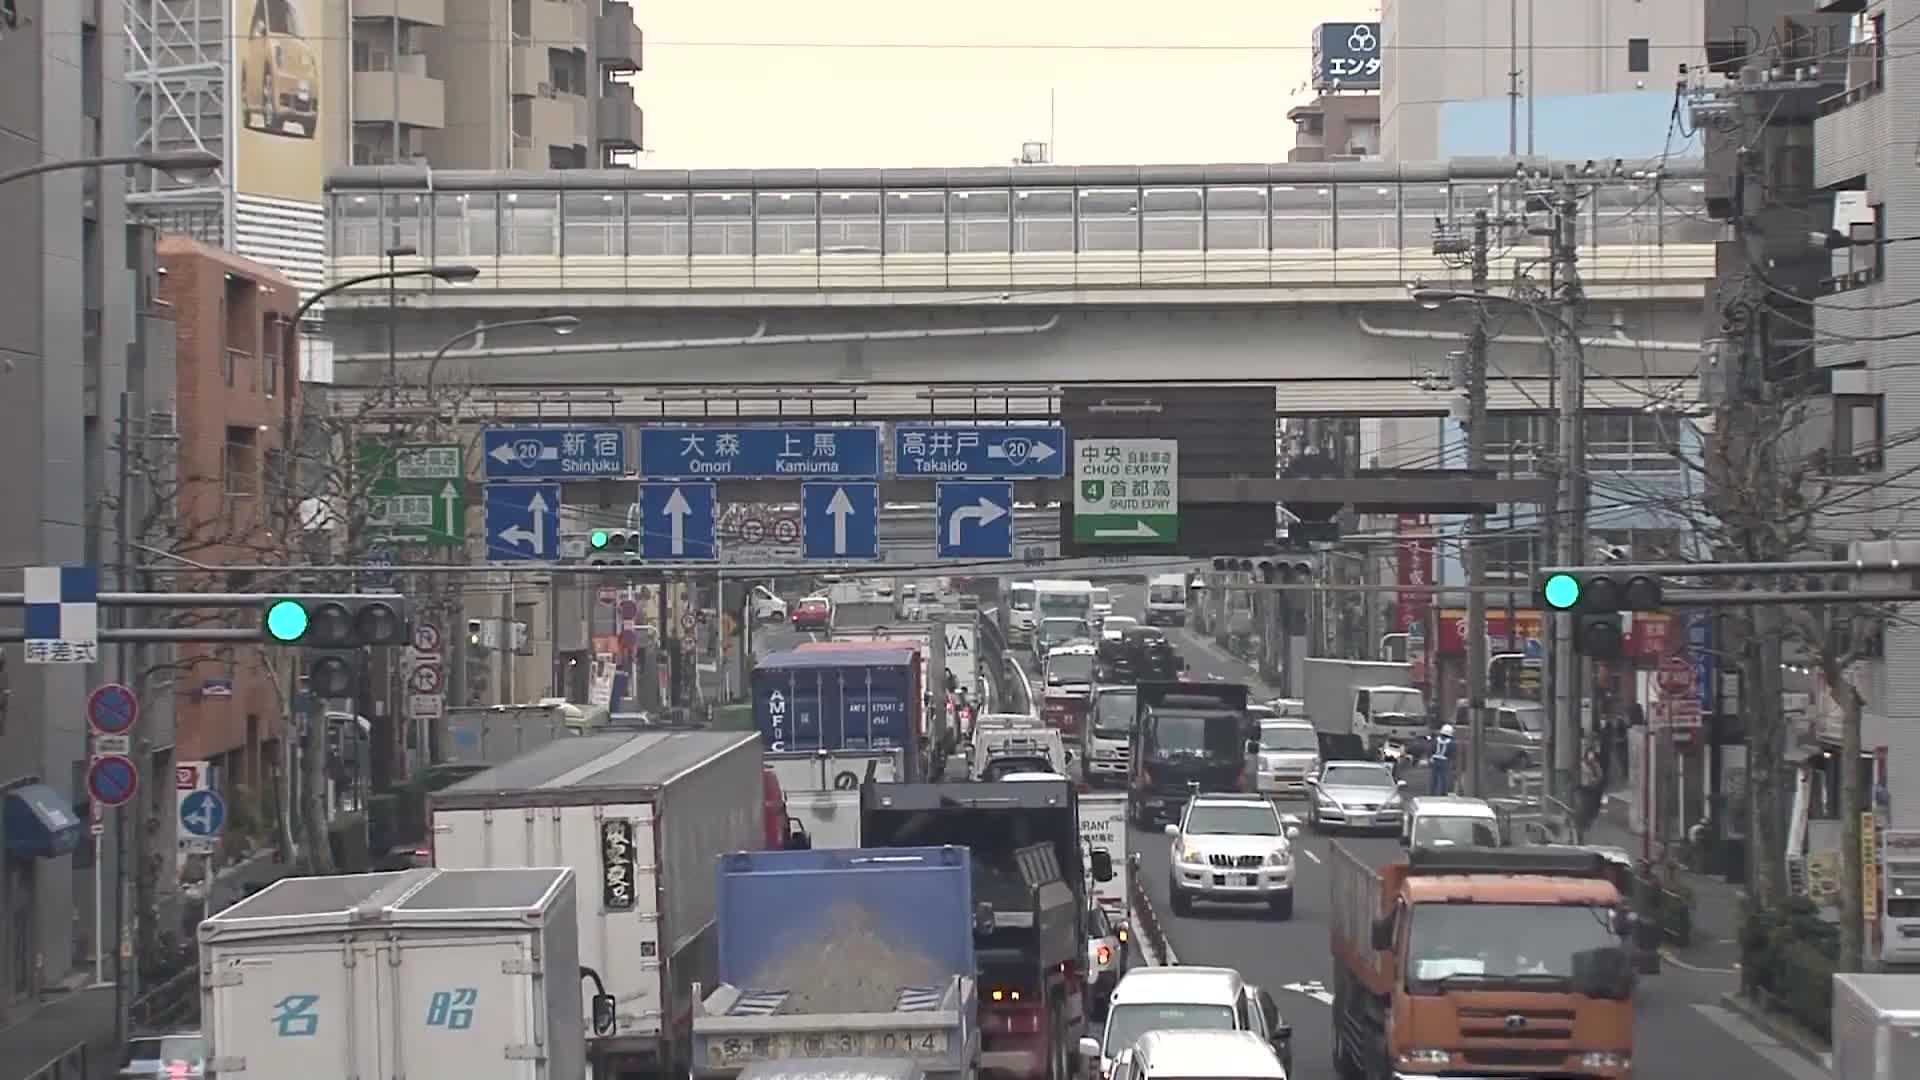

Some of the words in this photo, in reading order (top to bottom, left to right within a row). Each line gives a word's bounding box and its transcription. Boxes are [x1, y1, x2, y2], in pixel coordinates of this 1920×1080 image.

[518, 444, 537, 458] 20
[561, 432, 619, 456] 新宿
[680, 433, 740, 456] 大森
[778, 433, 836, 457] 上馬
[903, 432, 980, 456] 高井戸
[1008, 443, 1026, 457] 20
[561, 458, 620, 473] Shinjuku
[689, 459, 731, 472] Omori
[775, 459, 839, 472] Kamiuma
[914, 458, 968, 472] Takaido
[1083, 465, 1120, 475] CHUO
[1124, 465, 1169, 475] EXPWY
[1087, 484, 1097, 497] 4
[1111, 480, 1170, 498] 首都高
[26, 640, 96, 661] 時差式
[271, 994, 319, 1037] 名
[426, 988, 478, 1030] 昭
